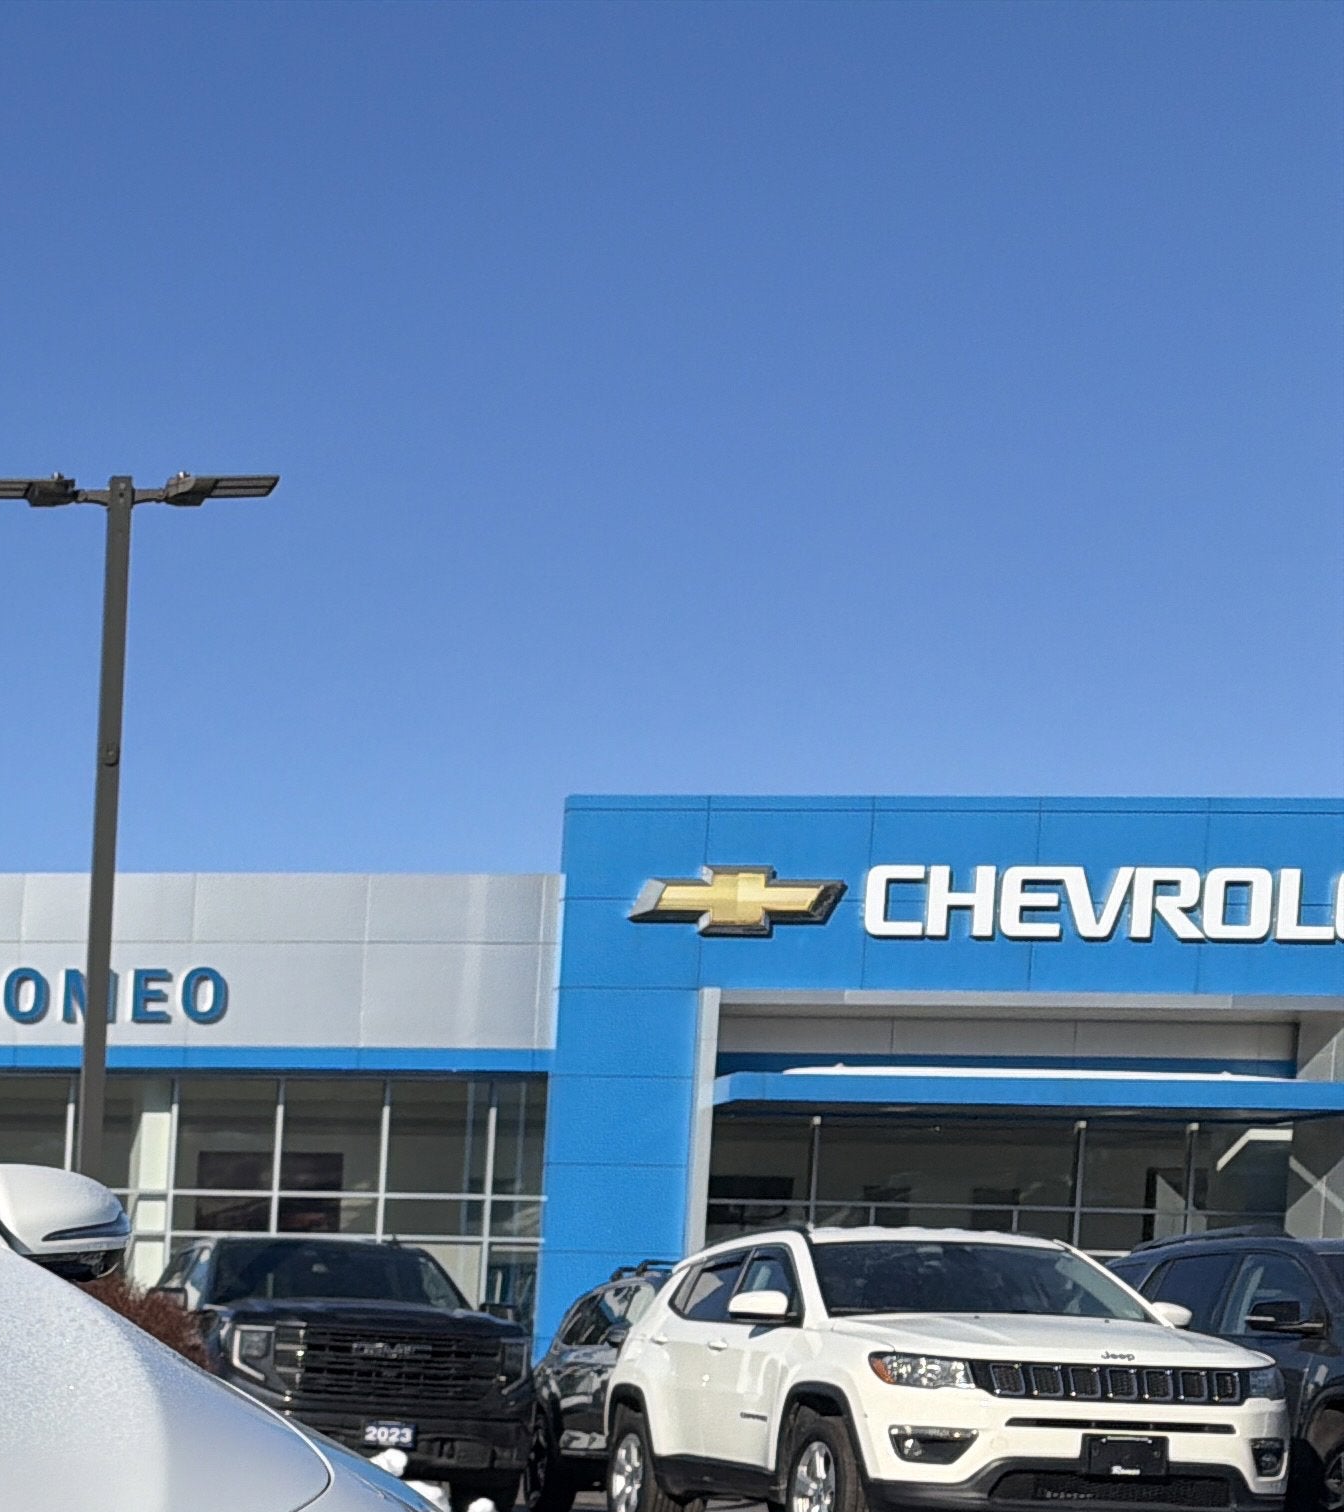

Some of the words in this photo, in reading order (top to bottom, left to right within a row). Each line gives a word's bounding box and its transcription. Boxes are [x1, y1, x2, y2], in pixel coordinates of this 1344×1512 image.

[864, 864, 1344, 941] CHEVROL
[1101, 1350, 1135, 1361] Jeep
[364, 1426, 412, 1443] 2023
